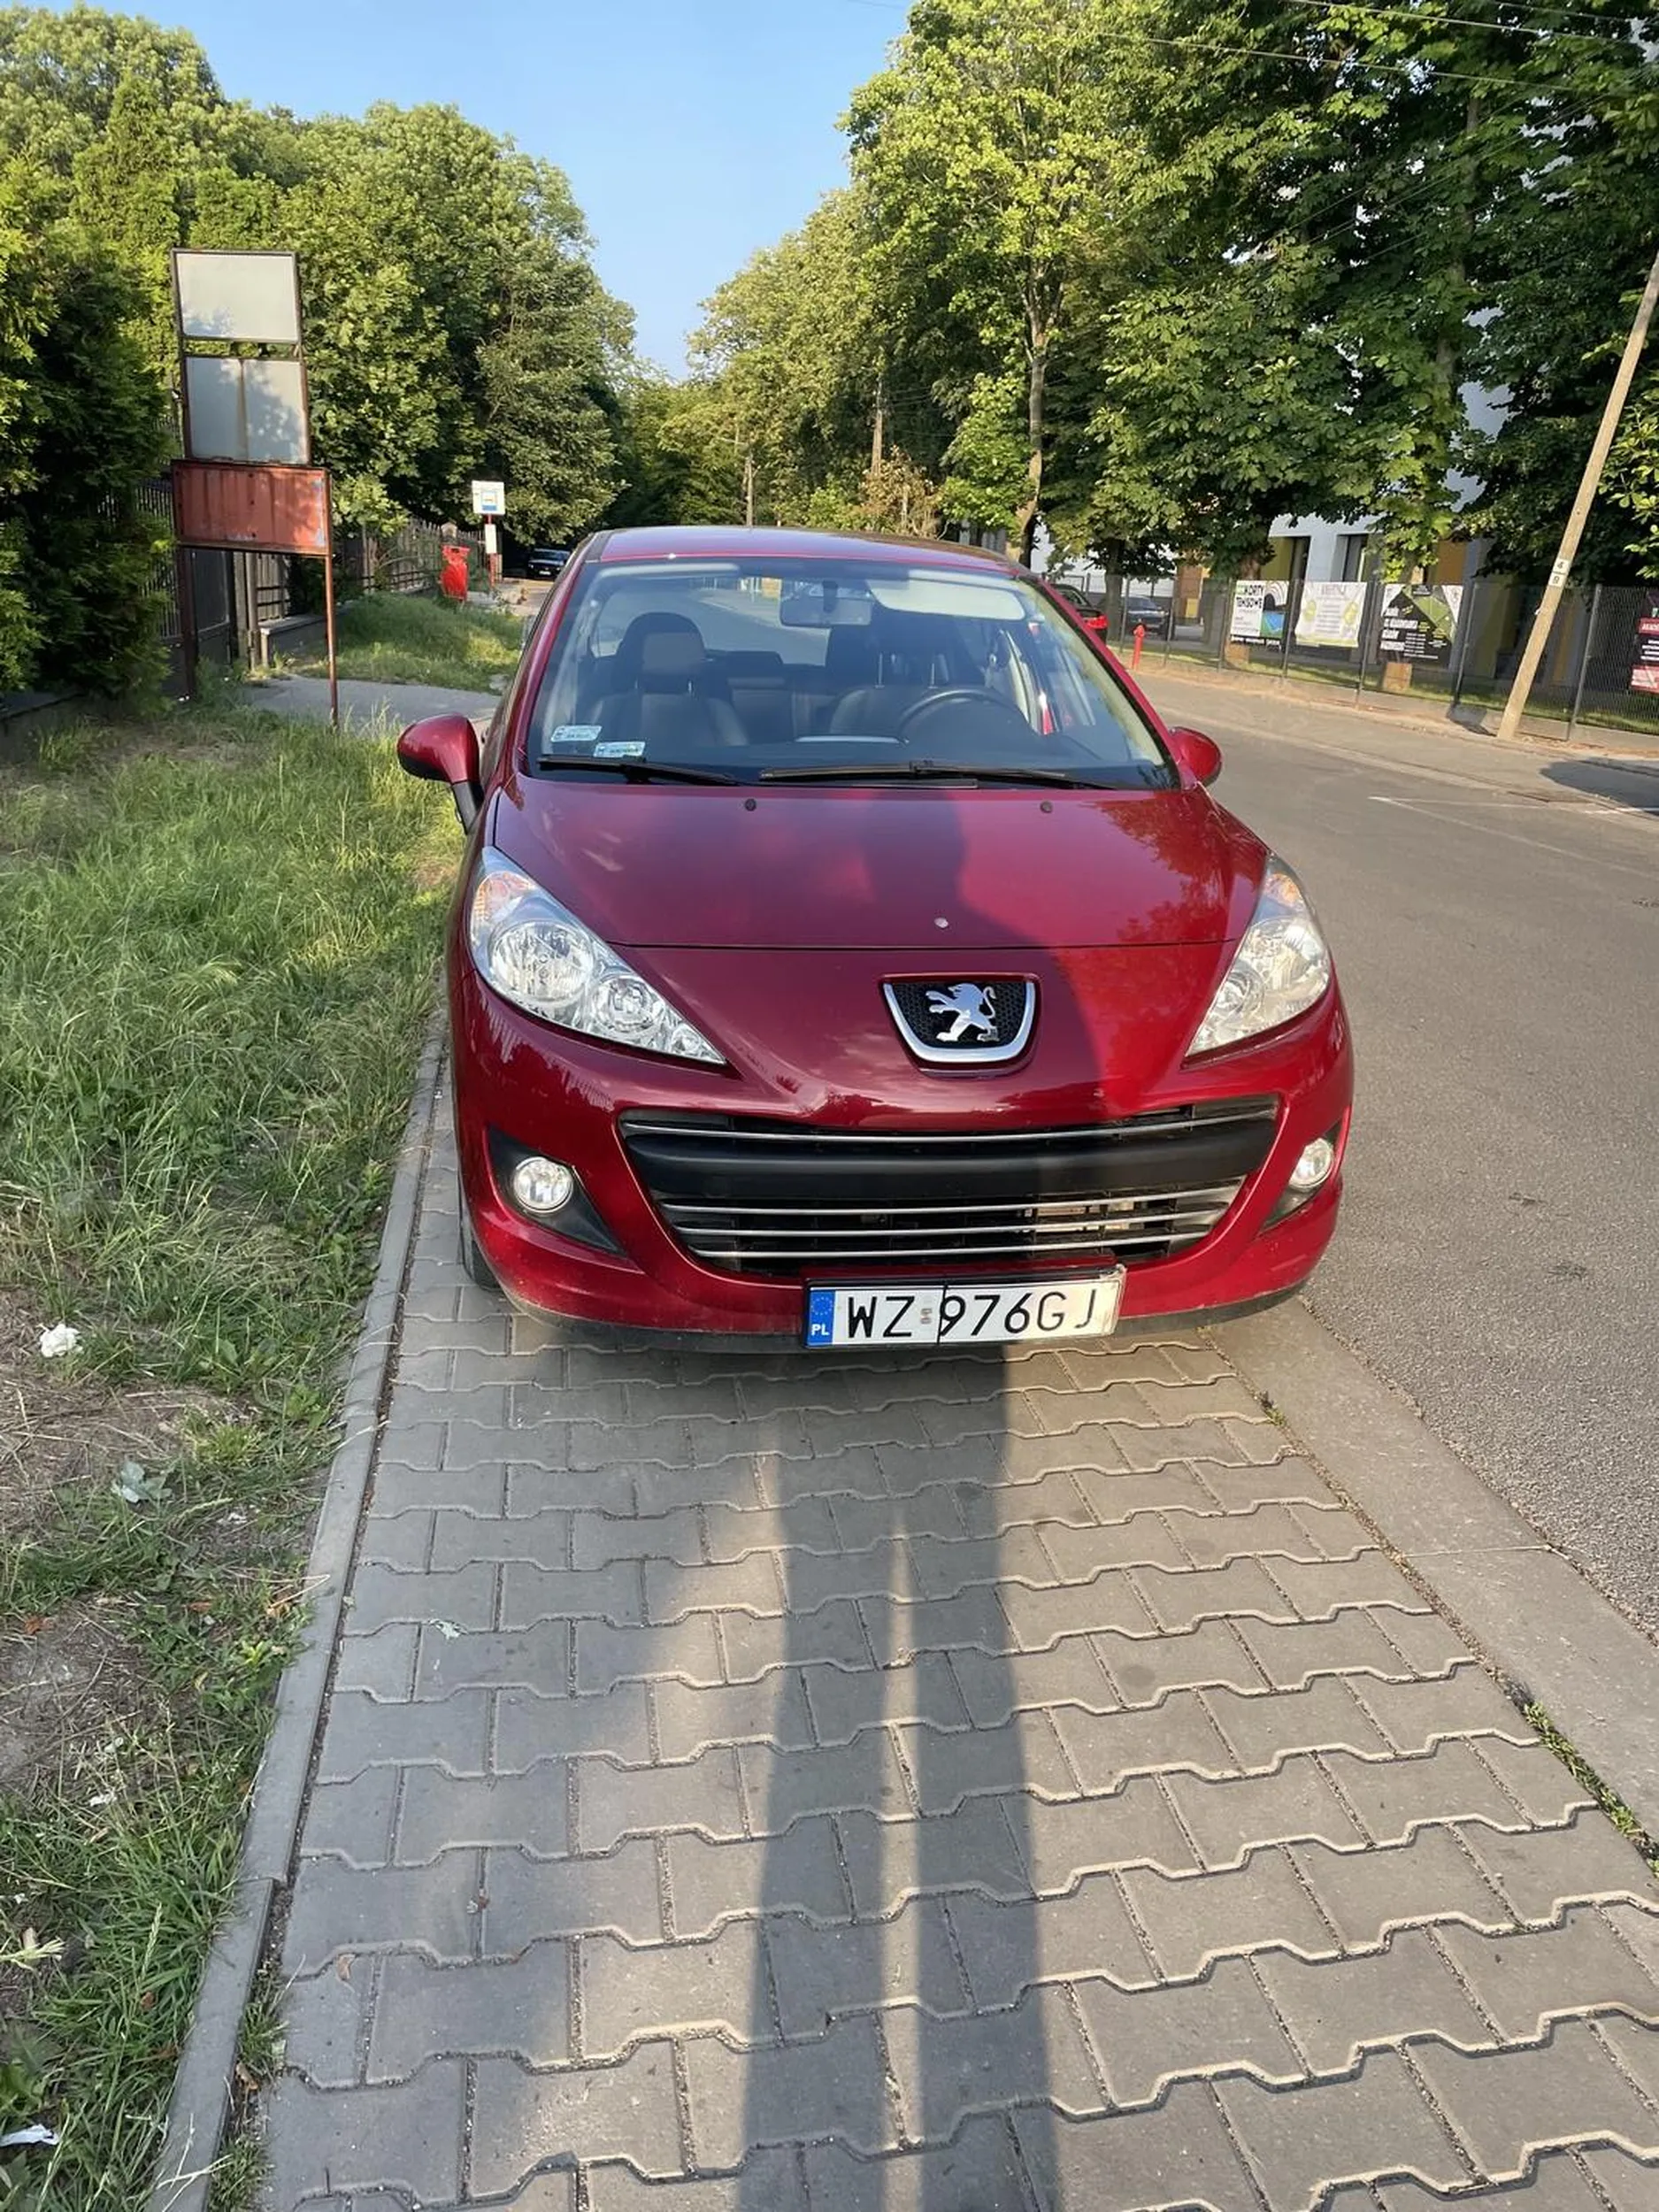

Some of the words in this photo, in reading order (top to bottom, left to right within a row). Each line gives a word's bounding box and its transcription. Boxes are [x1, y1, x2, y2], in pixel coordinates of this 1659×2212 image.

[848, 1295, 915, 1338] WZ
[939, 1289, 1097, 1336] 976GJ
[810, 1324, 830, 1336] PL
